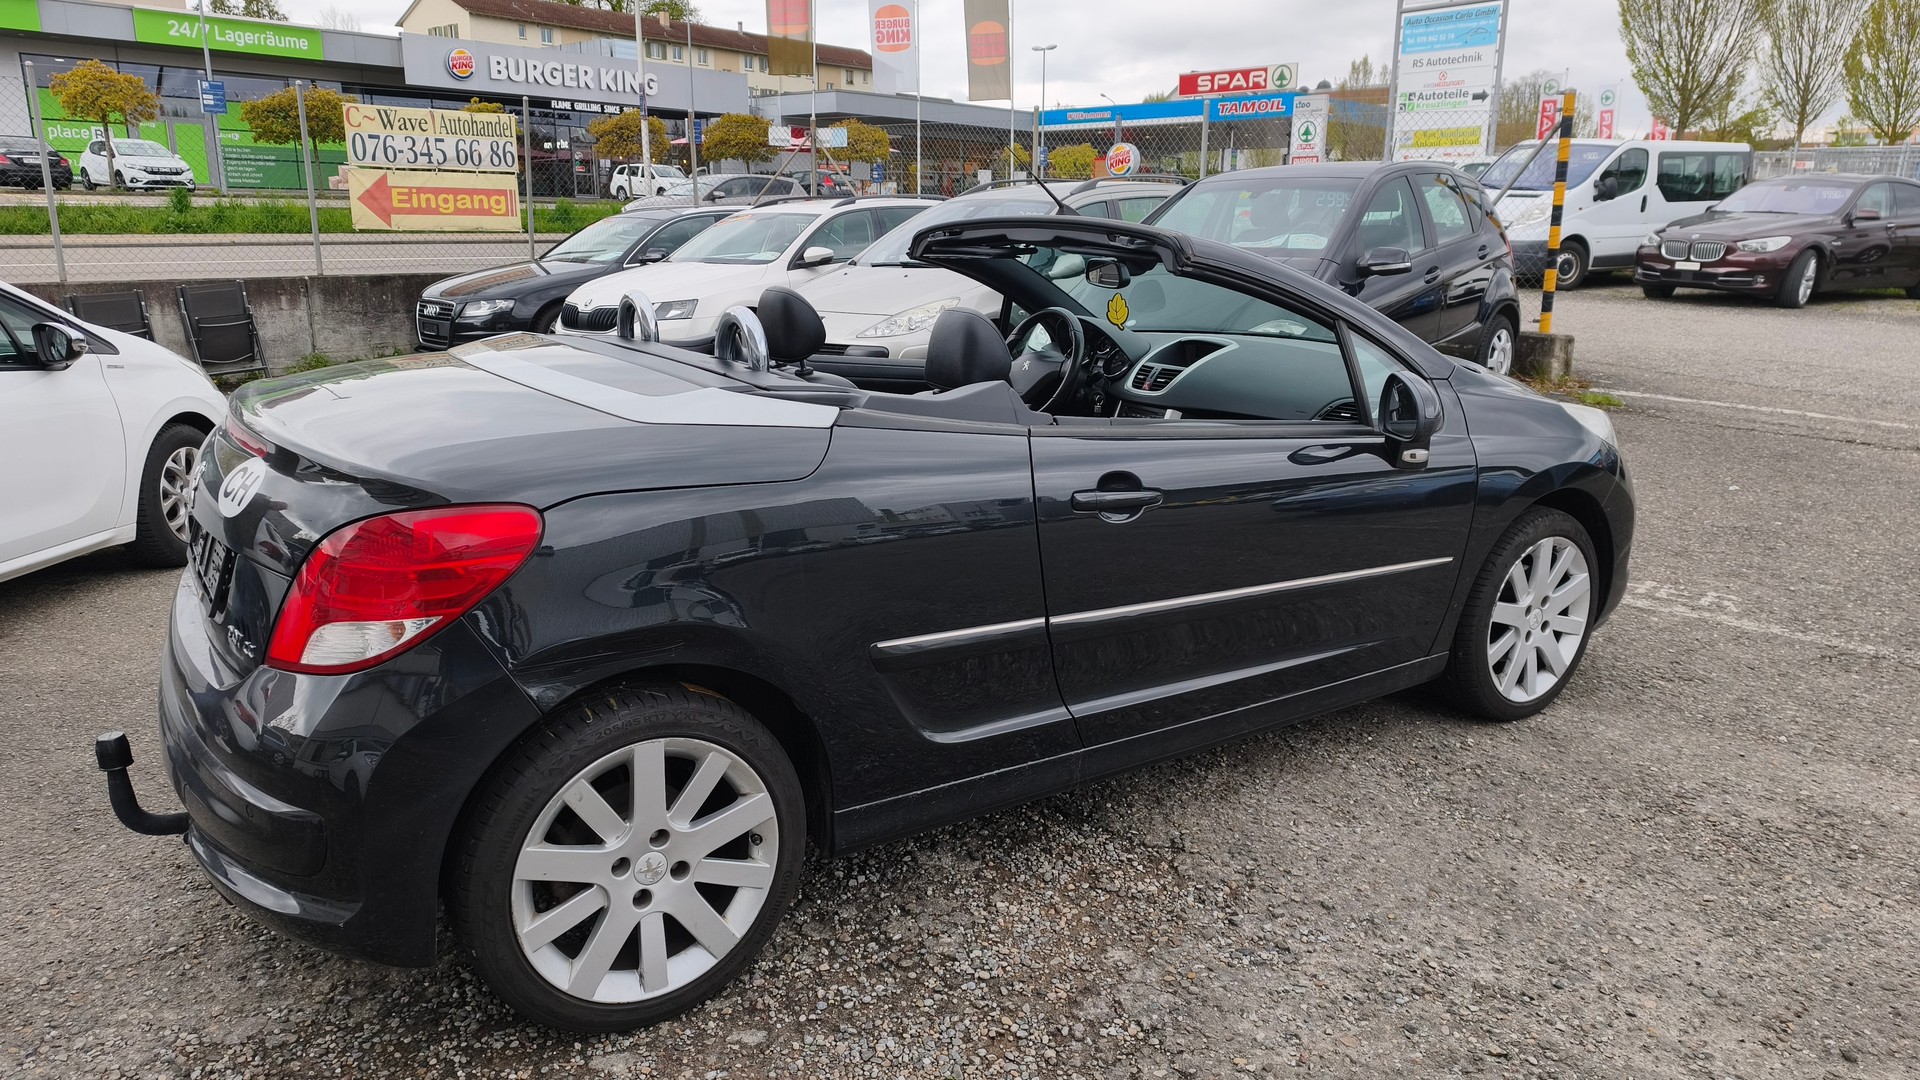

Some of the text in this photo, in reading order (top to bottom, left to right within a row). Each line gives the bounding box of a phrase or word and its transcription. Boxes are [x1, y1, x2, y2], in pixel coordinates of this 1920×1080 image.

[1406, 7, 1498, 26] Auto Occasion Carlo GmbH
[214, 25, 309, 50] Lagerräume
[451, 61, 474, 70] KING
[1412, 52, 1482, 68] RS Autotechnik
[488, 55, 659, 96] BURGER KING
[1196, 70, 1267, 91] SPAR
[1417, 88, 1470, 101] Autoteile
[551, 100, 572, 110] FLAME
[574, 102, 602, 112] GRILLING
[603, 104, 620, 114] SINCE
[1218, 98, 1286, 114] TAMOIL
[1416, 100, 1468, 109] Kreuzlingen
[1067, 111, 1112, 120] Willkommen
[439, 113, 514, 138] Autohandel
[351, 132, 516, 168] 076-345 66 86
[1109, 150, 1130, 162] BURGER
[1109, 158, 1130, 170] KING
[391, 188, 507, 215] Eingang
[223, 466, 261, 507] CH
